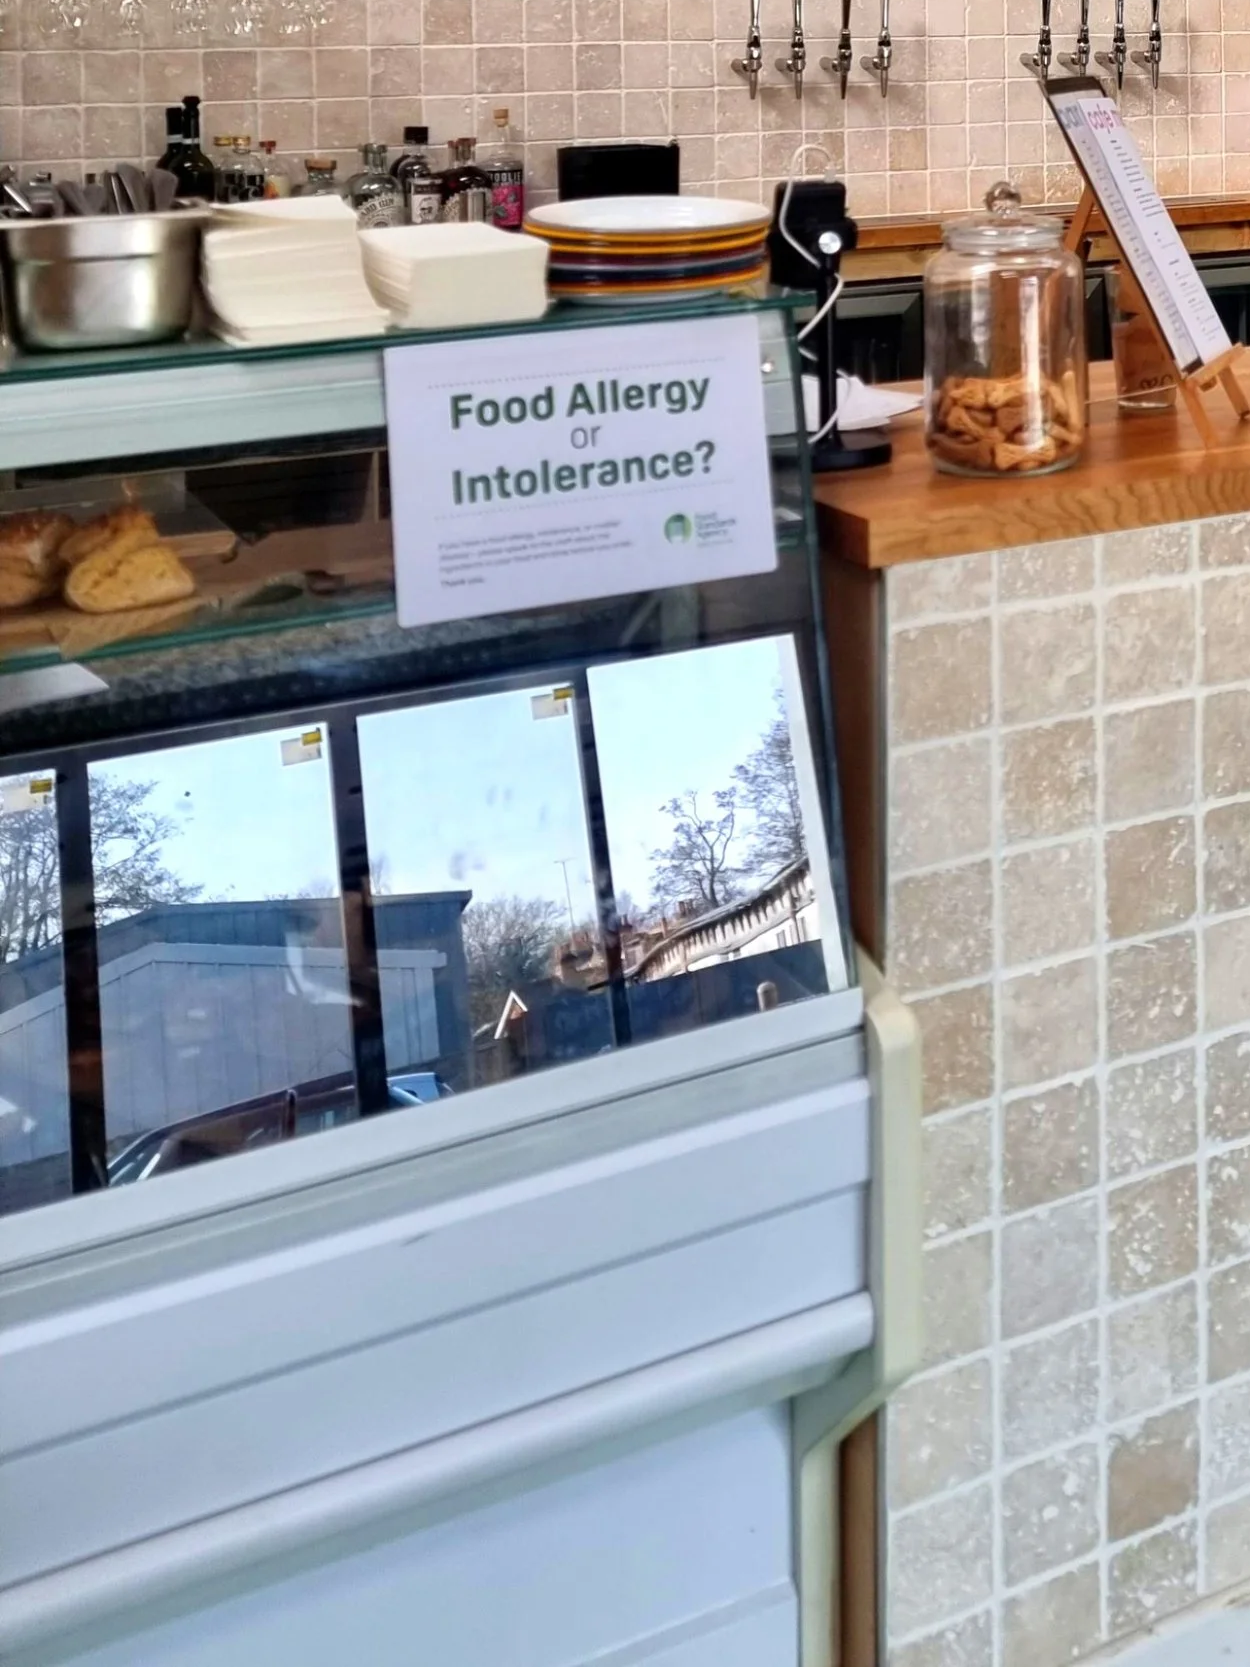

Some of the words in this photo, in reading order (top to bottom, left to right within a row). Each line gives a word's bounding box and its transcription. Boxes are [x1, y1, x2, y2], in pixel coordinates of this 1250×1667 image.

[450, 386, 555, 430] Food
[566, 377, 710, 417] Allergy
[570, 425, 603, 450] or
[452, 439, 716, 505] Intolerance?
